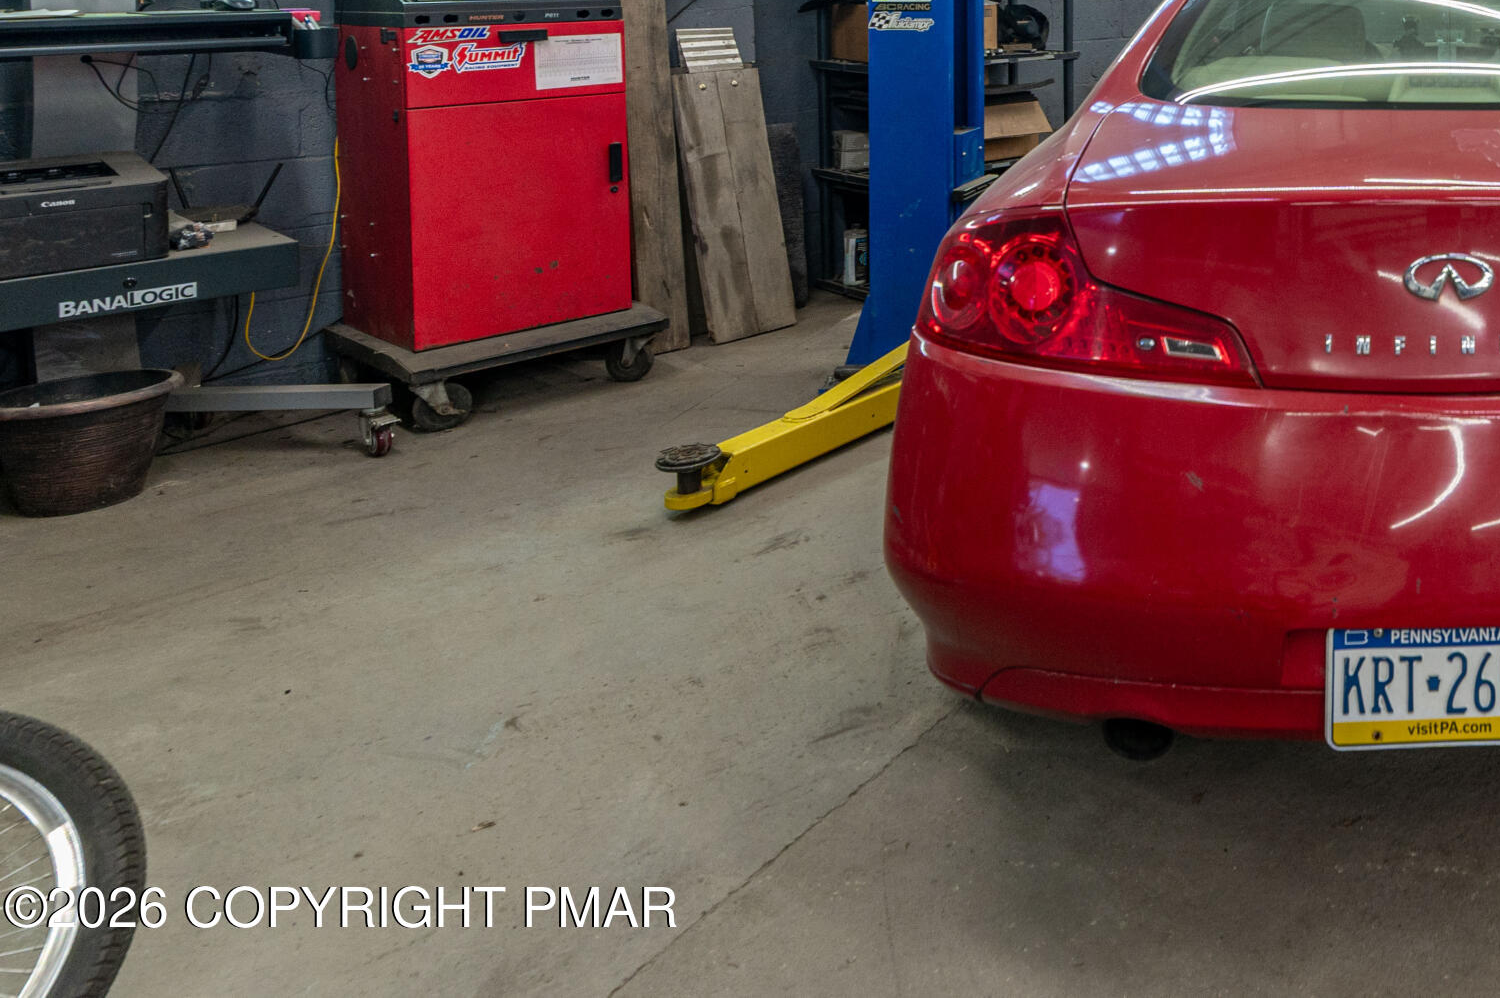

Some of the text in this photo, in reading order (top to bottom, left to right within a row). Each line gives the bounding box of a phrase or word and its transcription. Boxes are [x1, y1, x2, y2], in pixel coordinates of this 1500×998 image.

[410, 26, 489, 44] AMSOIL
[41, 199, 75, 208] Canon
[58, 283, 197, 319] BANALOGIC
[1407, 720, 1492, 736] visitPA.com
